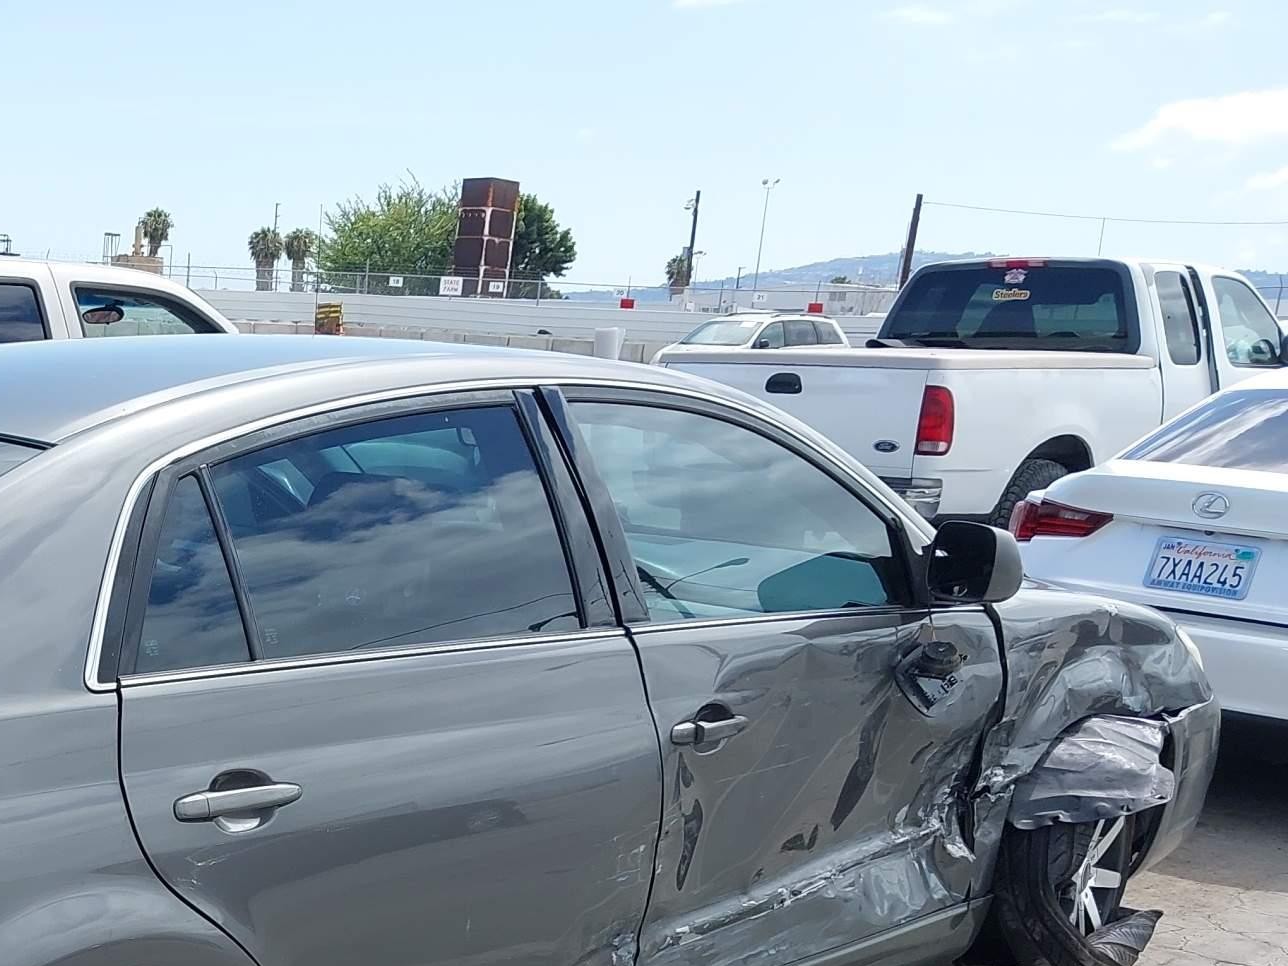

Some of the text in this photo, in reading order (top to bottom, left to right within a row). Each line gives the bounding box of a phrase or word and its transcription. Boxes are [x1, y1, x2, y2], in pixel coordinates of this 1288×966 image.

[994, 289, 1029, 299] Steelers
[1163, 543, 1236, 561] JAN California
[1157, 556, 1245, 589] 7XAA245
